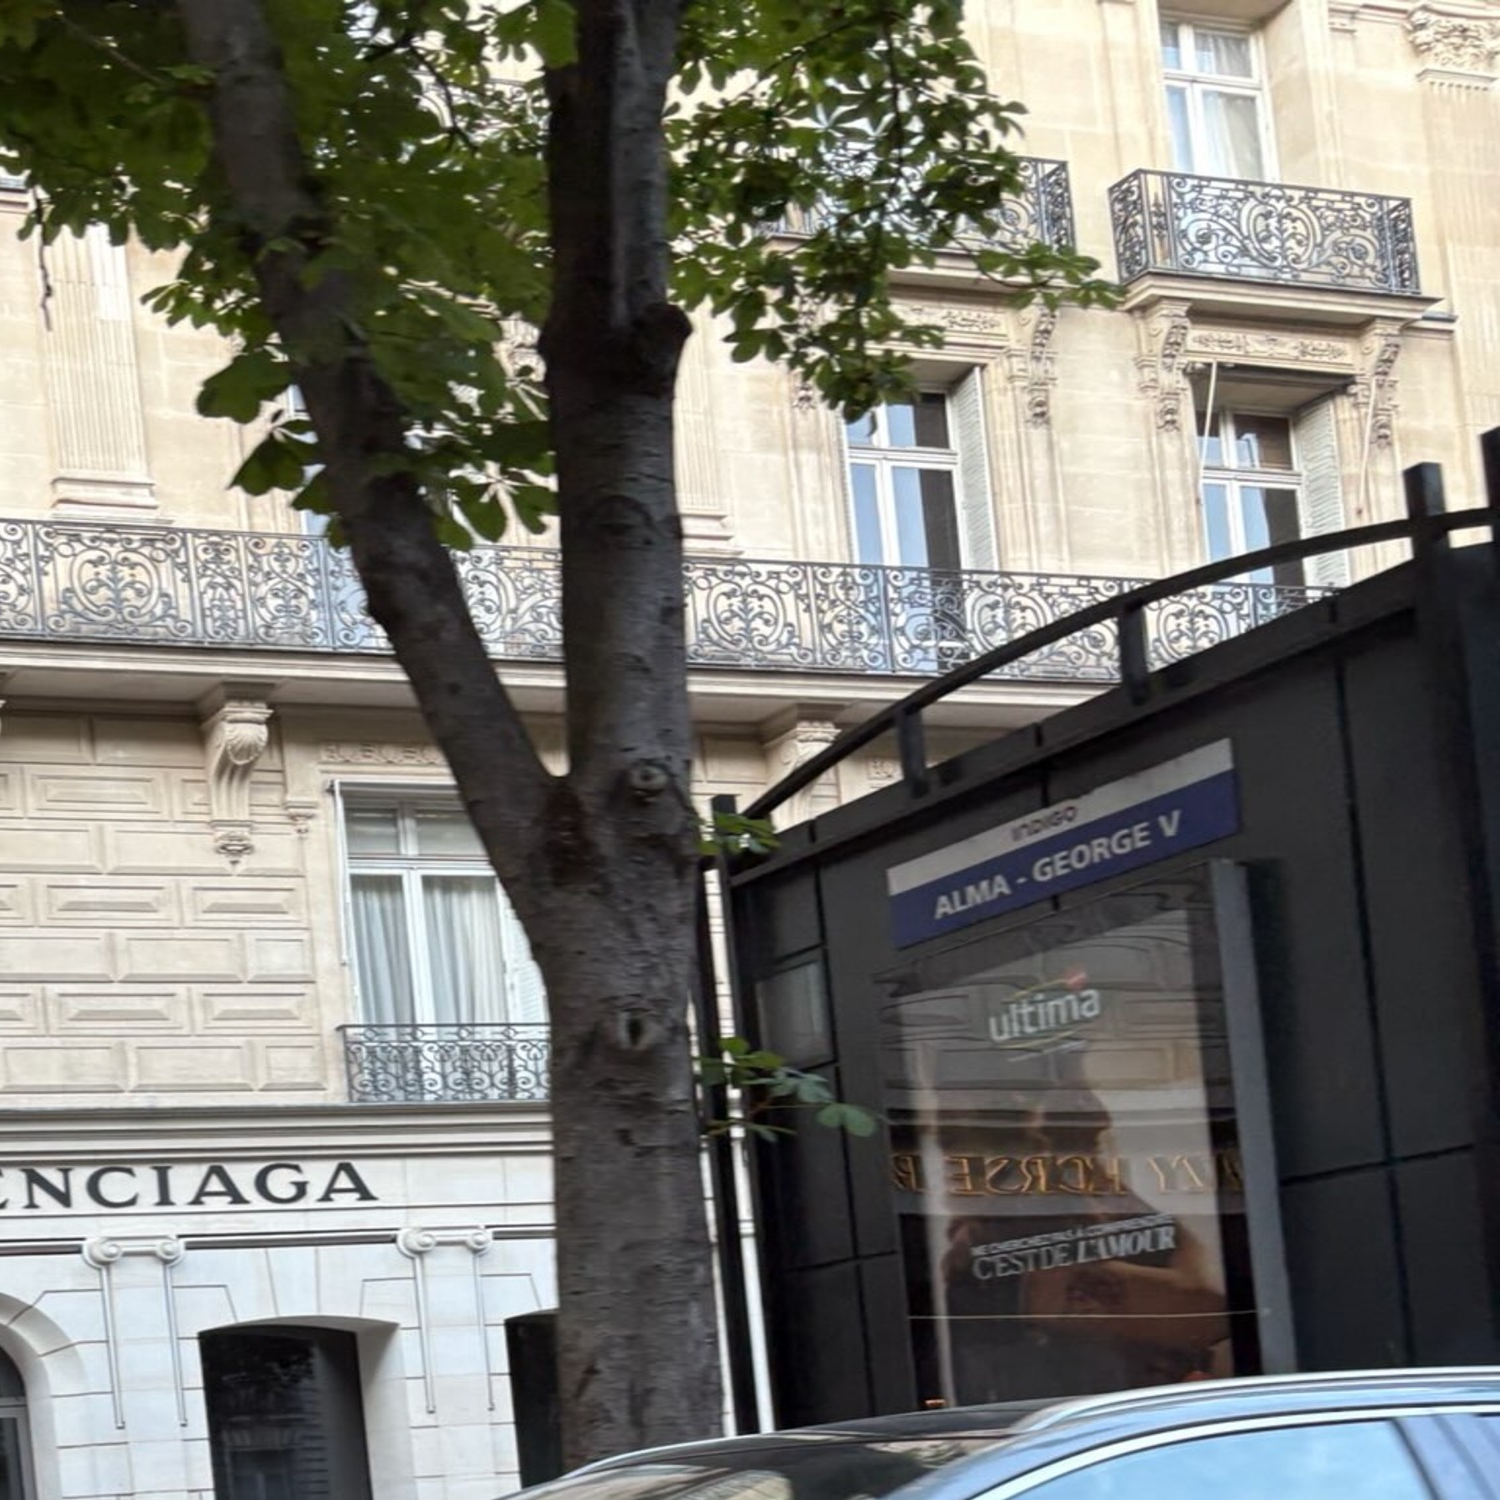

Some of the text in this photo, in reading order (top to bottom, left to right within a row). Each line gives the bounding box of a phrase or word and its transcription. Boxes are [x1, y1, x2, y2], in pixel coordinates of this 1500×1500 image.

[933, 874, 1012, 920] ALMA
[1031, 821, 1152, 883] GEORGE
[1156, 809, 1183, 838] V
[989, 988, 1100, 1042] ultima
[1077, 1226, 1177, 1264] L'AMOUR
